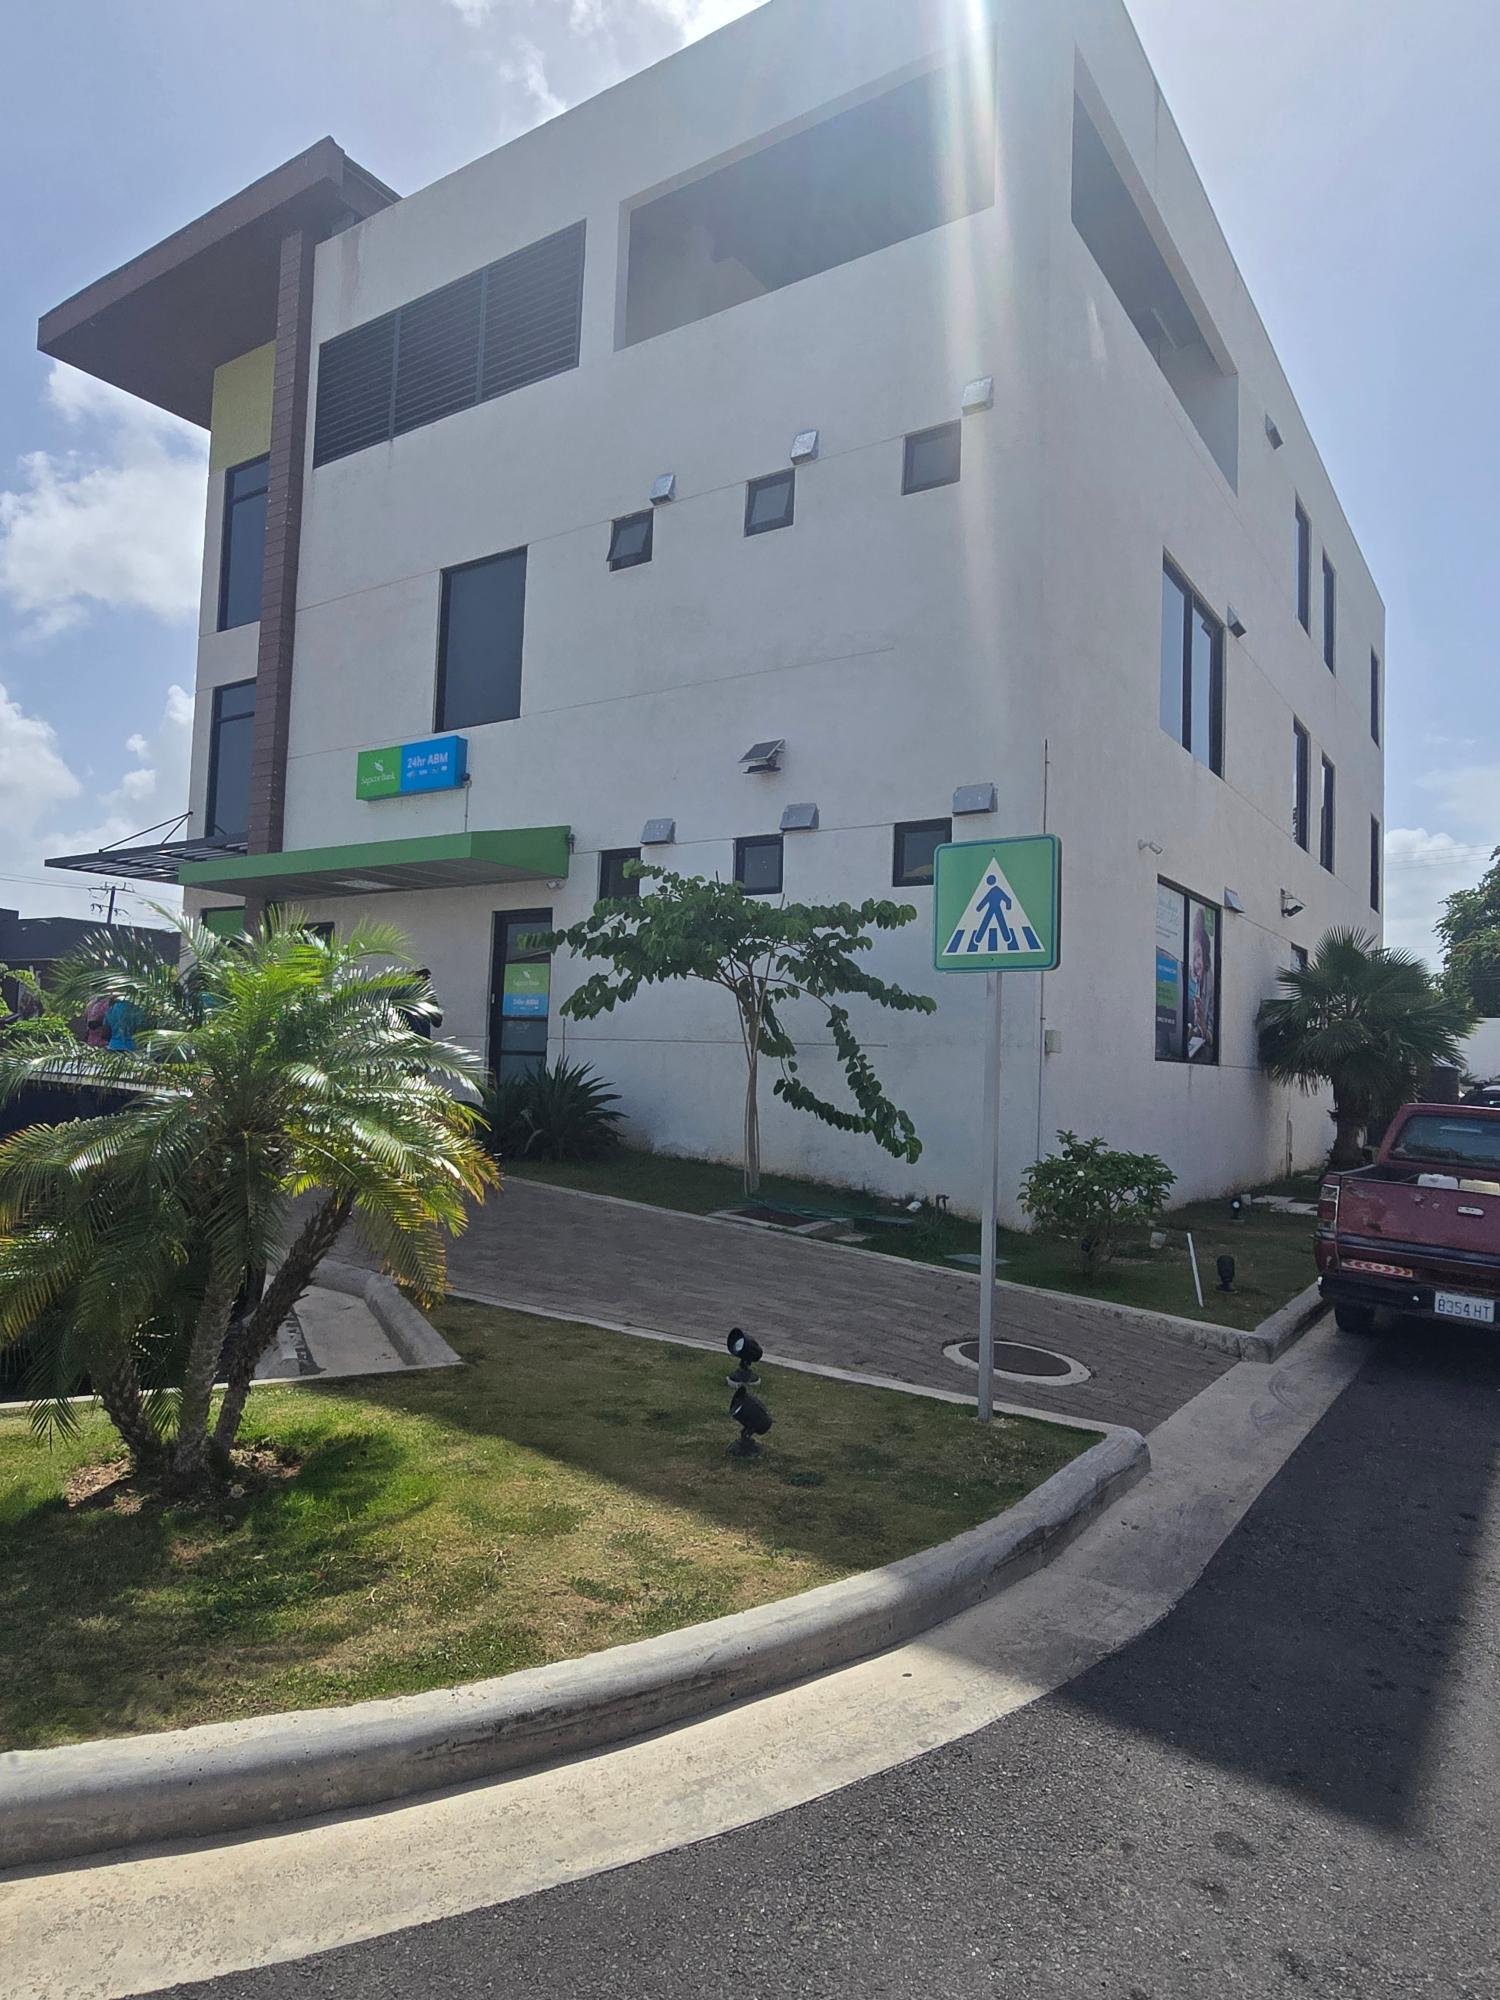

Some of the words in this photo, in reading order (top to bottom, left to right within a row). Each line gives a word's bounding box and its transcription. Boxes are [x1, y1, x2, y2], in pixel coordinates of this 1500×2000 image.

[407, 755, 426, 769] 24hr
[427, 752, 448, 765] ABM
[1438, 1298, 1470, 1316] 8354
[1474, 1303, 1491, 1320] HT
